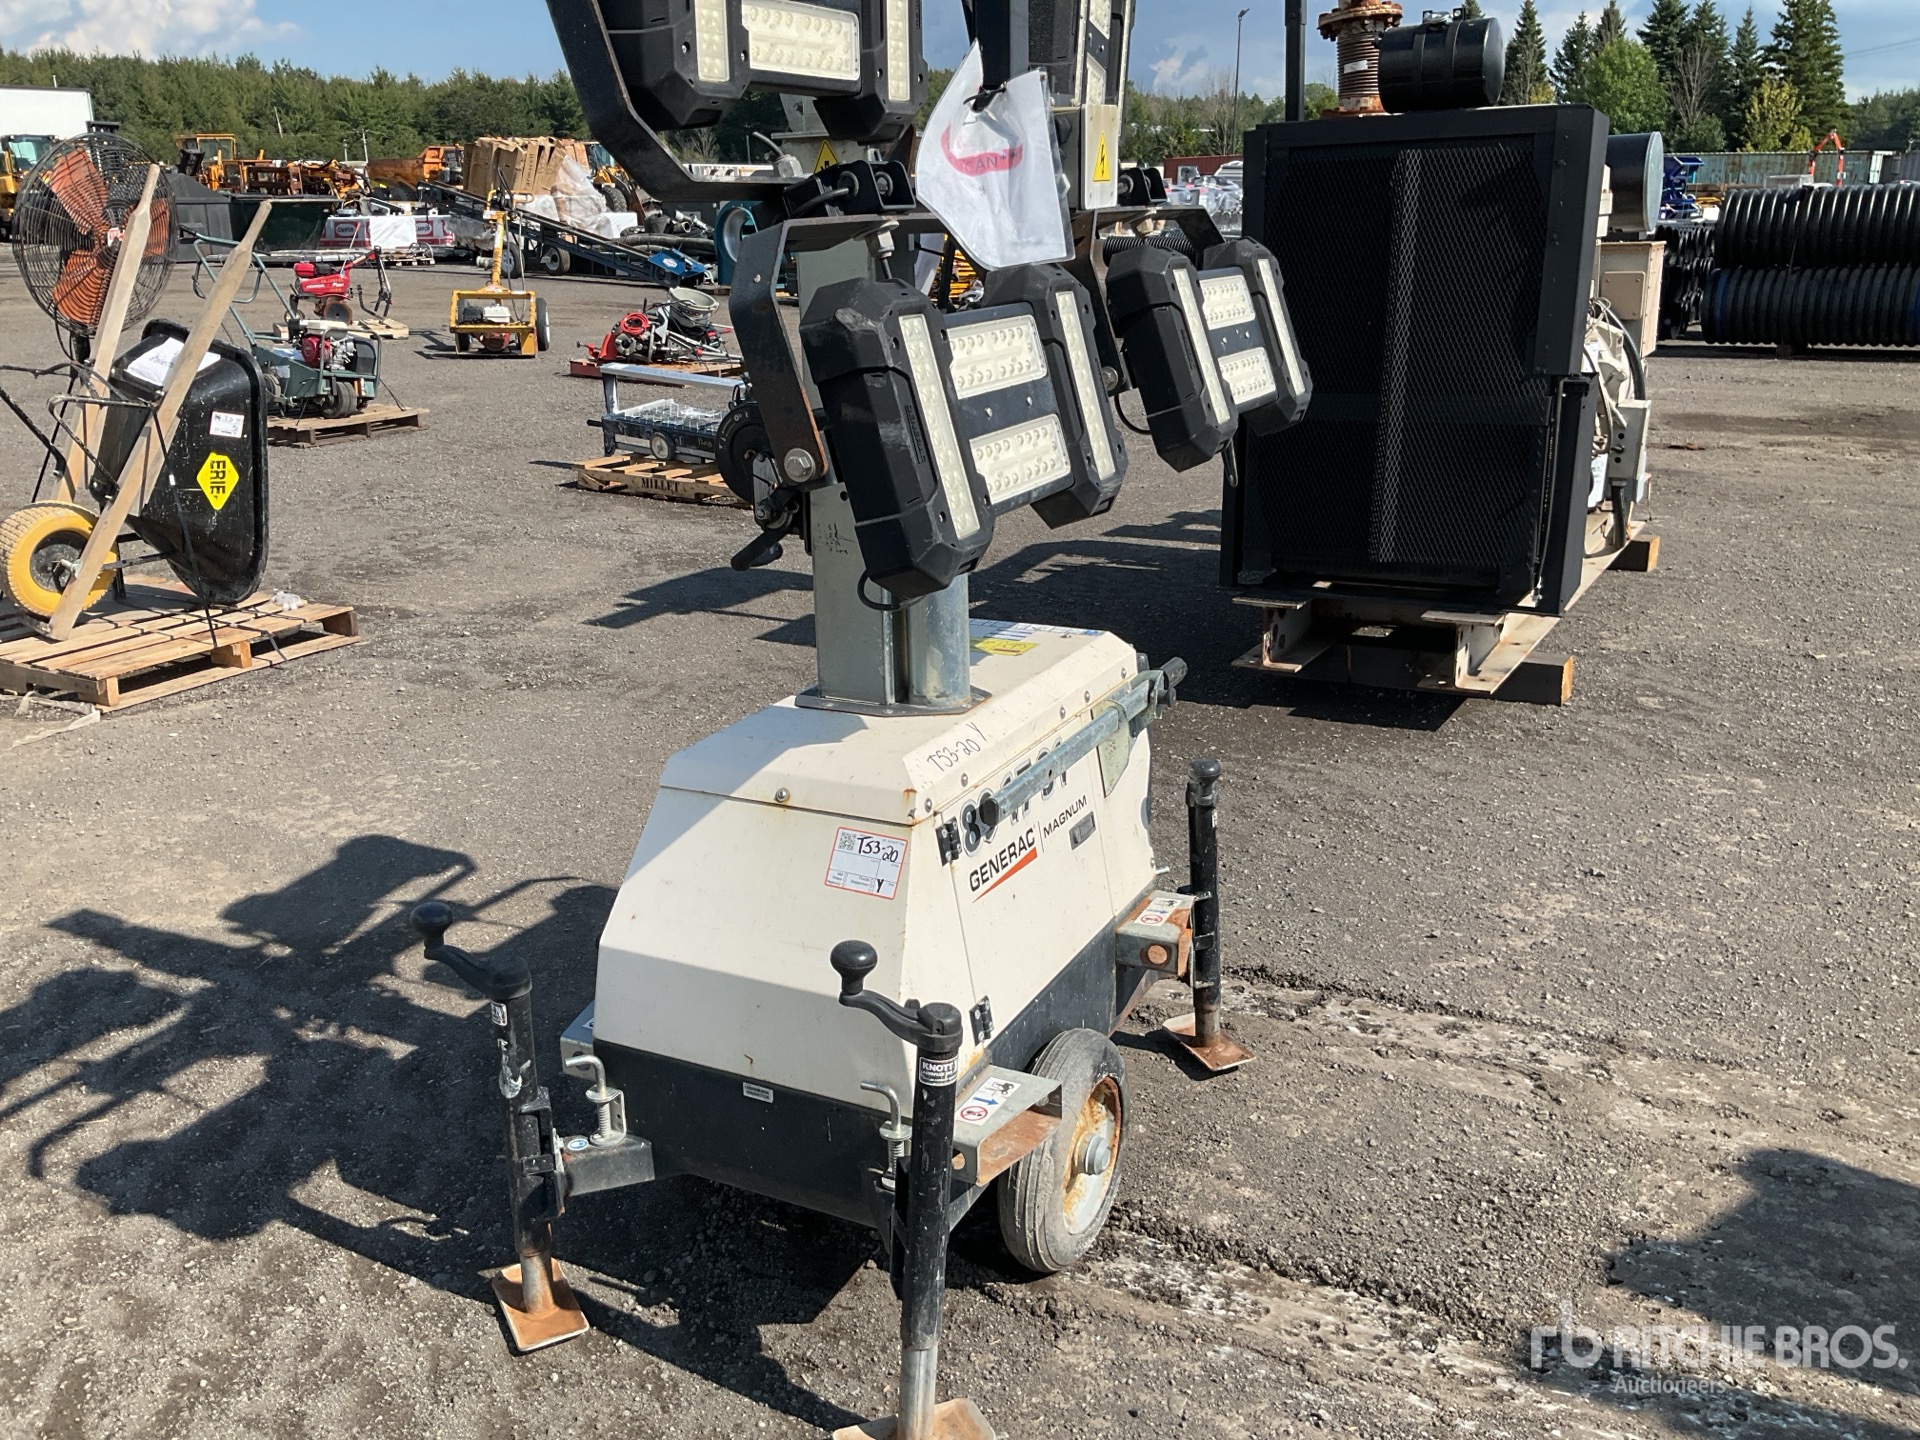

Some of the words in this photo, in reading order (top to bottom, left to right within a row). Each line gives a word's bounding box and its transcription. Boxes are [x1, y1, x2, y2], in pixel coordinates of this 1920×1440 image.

[526, 153, 534, 186] armacell
[210, 460, 226, 494] ERIE
[641, 477, 680, 492] MILLET
[926, 738, 981, 772] T53-20
[857, 836, 899, 863] T53-20
[968, 827, 1036, 892] GENERAC
[1043, 795, 1088, 839] MAGNUM
[922, 1062, 954, 1072] KNOTT
